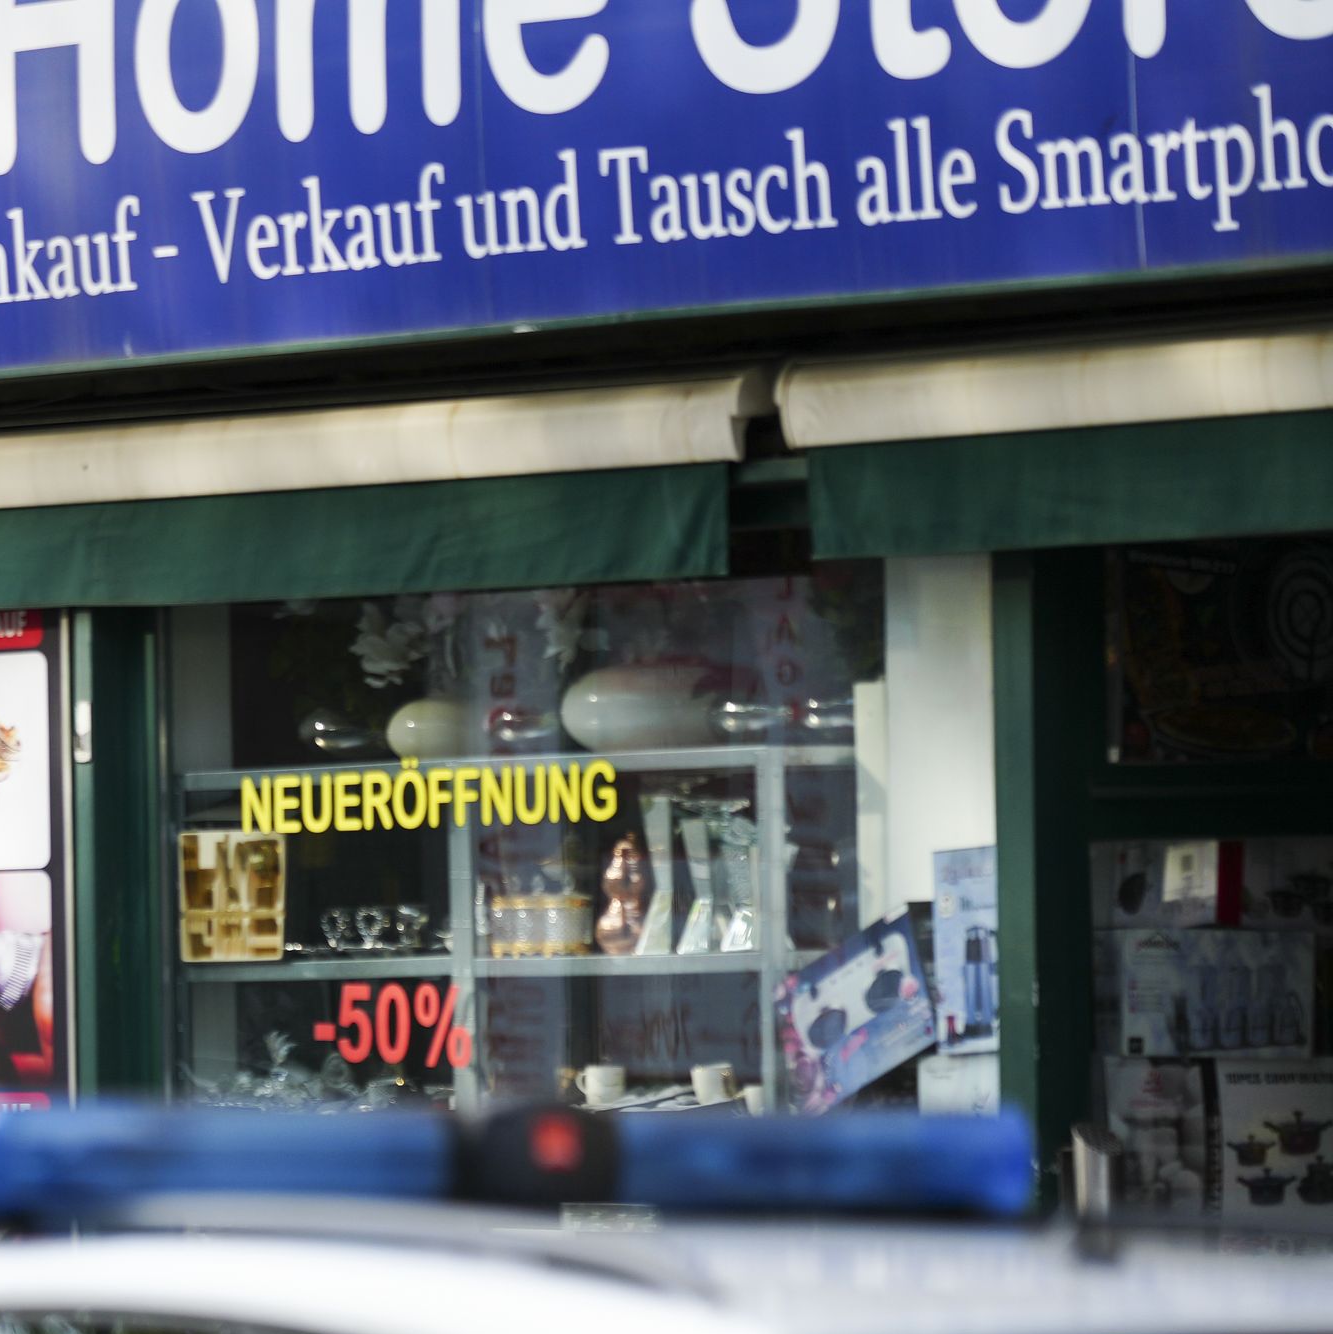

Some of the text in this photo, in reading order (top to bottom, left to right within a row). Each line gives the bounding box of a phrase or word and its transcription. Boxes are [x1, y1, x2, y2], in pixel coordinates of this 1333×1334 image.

[194, 163, 443, 284] Verkauf
[456, 148, 586, 261] und
[600, 127, 836, 246] Tausch
[855, 118, 976, 228] alle
[239, 756, 618, 834] NEUERÖFFNUNG
[313, 982, 472, 1068] -50%
